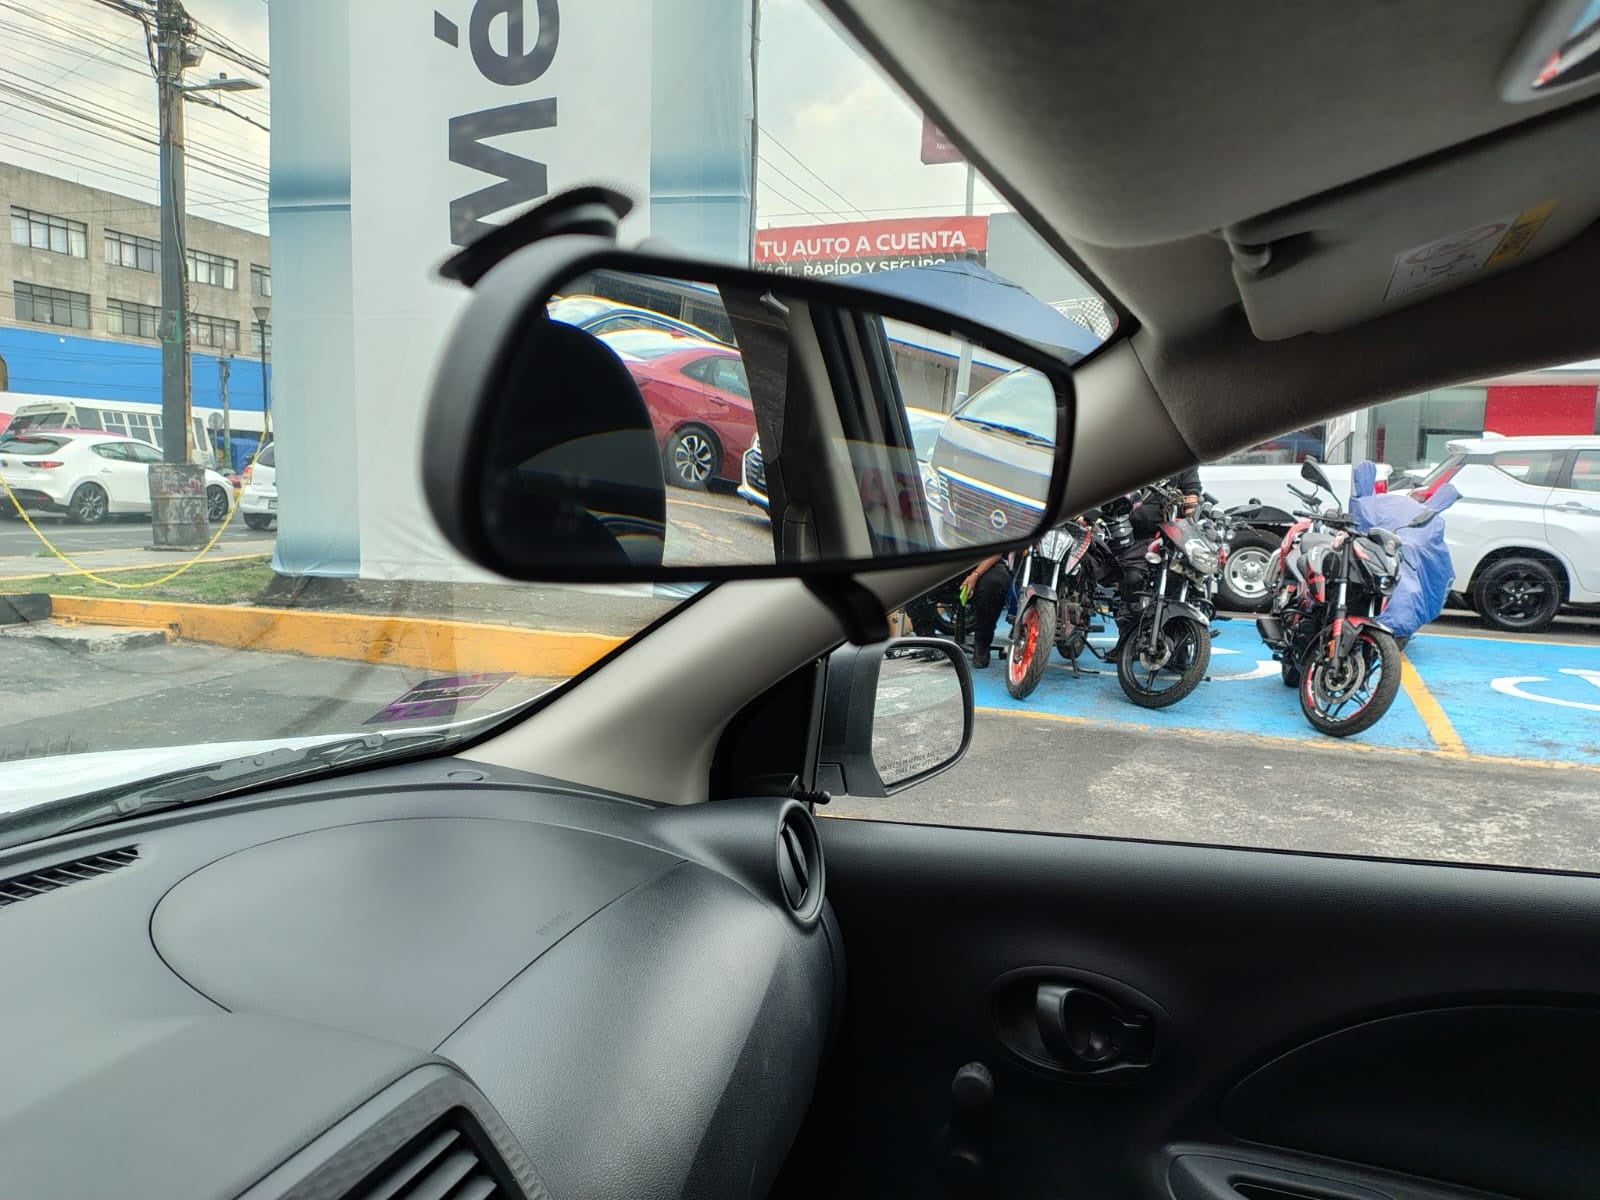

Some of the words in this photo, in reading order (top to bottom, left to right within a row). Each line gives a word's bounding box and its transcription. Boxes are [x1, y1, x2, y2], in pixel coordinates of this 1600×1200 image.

[759, 240, 787, 257] TU
[791, 237, 850, 256] AUTO
[855, 235, 871, 252] A
[876, 230, 966, 251] CUENTA
[865, 261, 876, 274] Y
